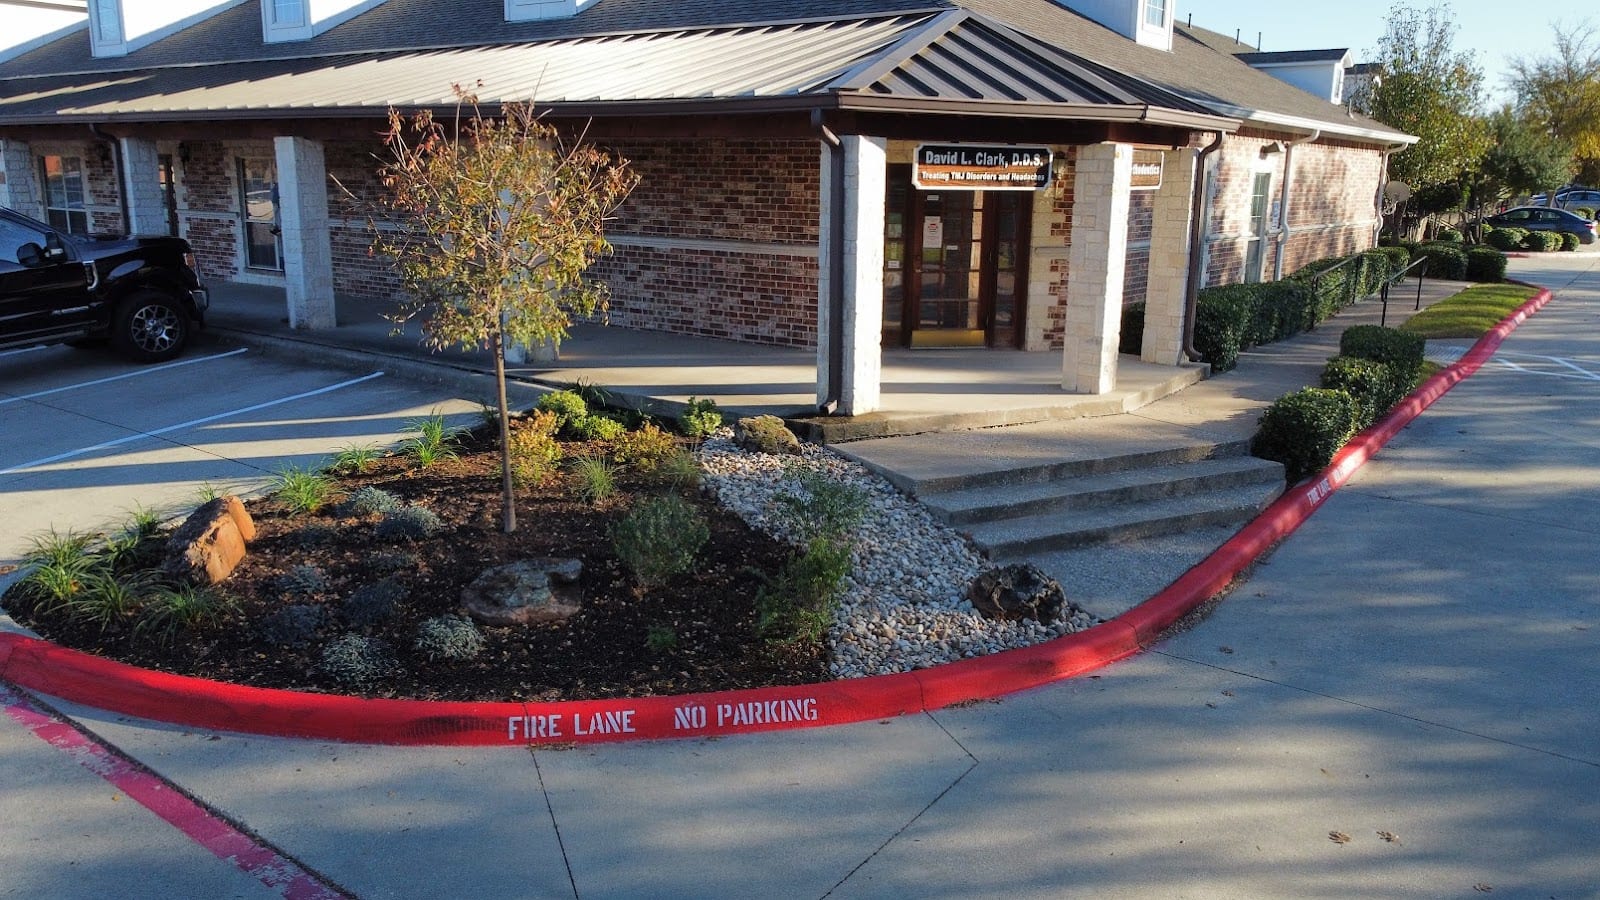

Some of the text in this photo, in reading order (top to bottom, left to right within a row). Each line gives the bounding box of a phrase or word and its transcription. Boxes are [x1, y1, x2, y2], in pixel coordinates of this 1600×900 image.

[925, 151, 1044, 168] David L. Clark, D.D.S.
[922, 171, 1045, 182] Treating TMJ Disorders and Headaches
[508, 698, 818, 740] FIRE LANE NO PARKING
